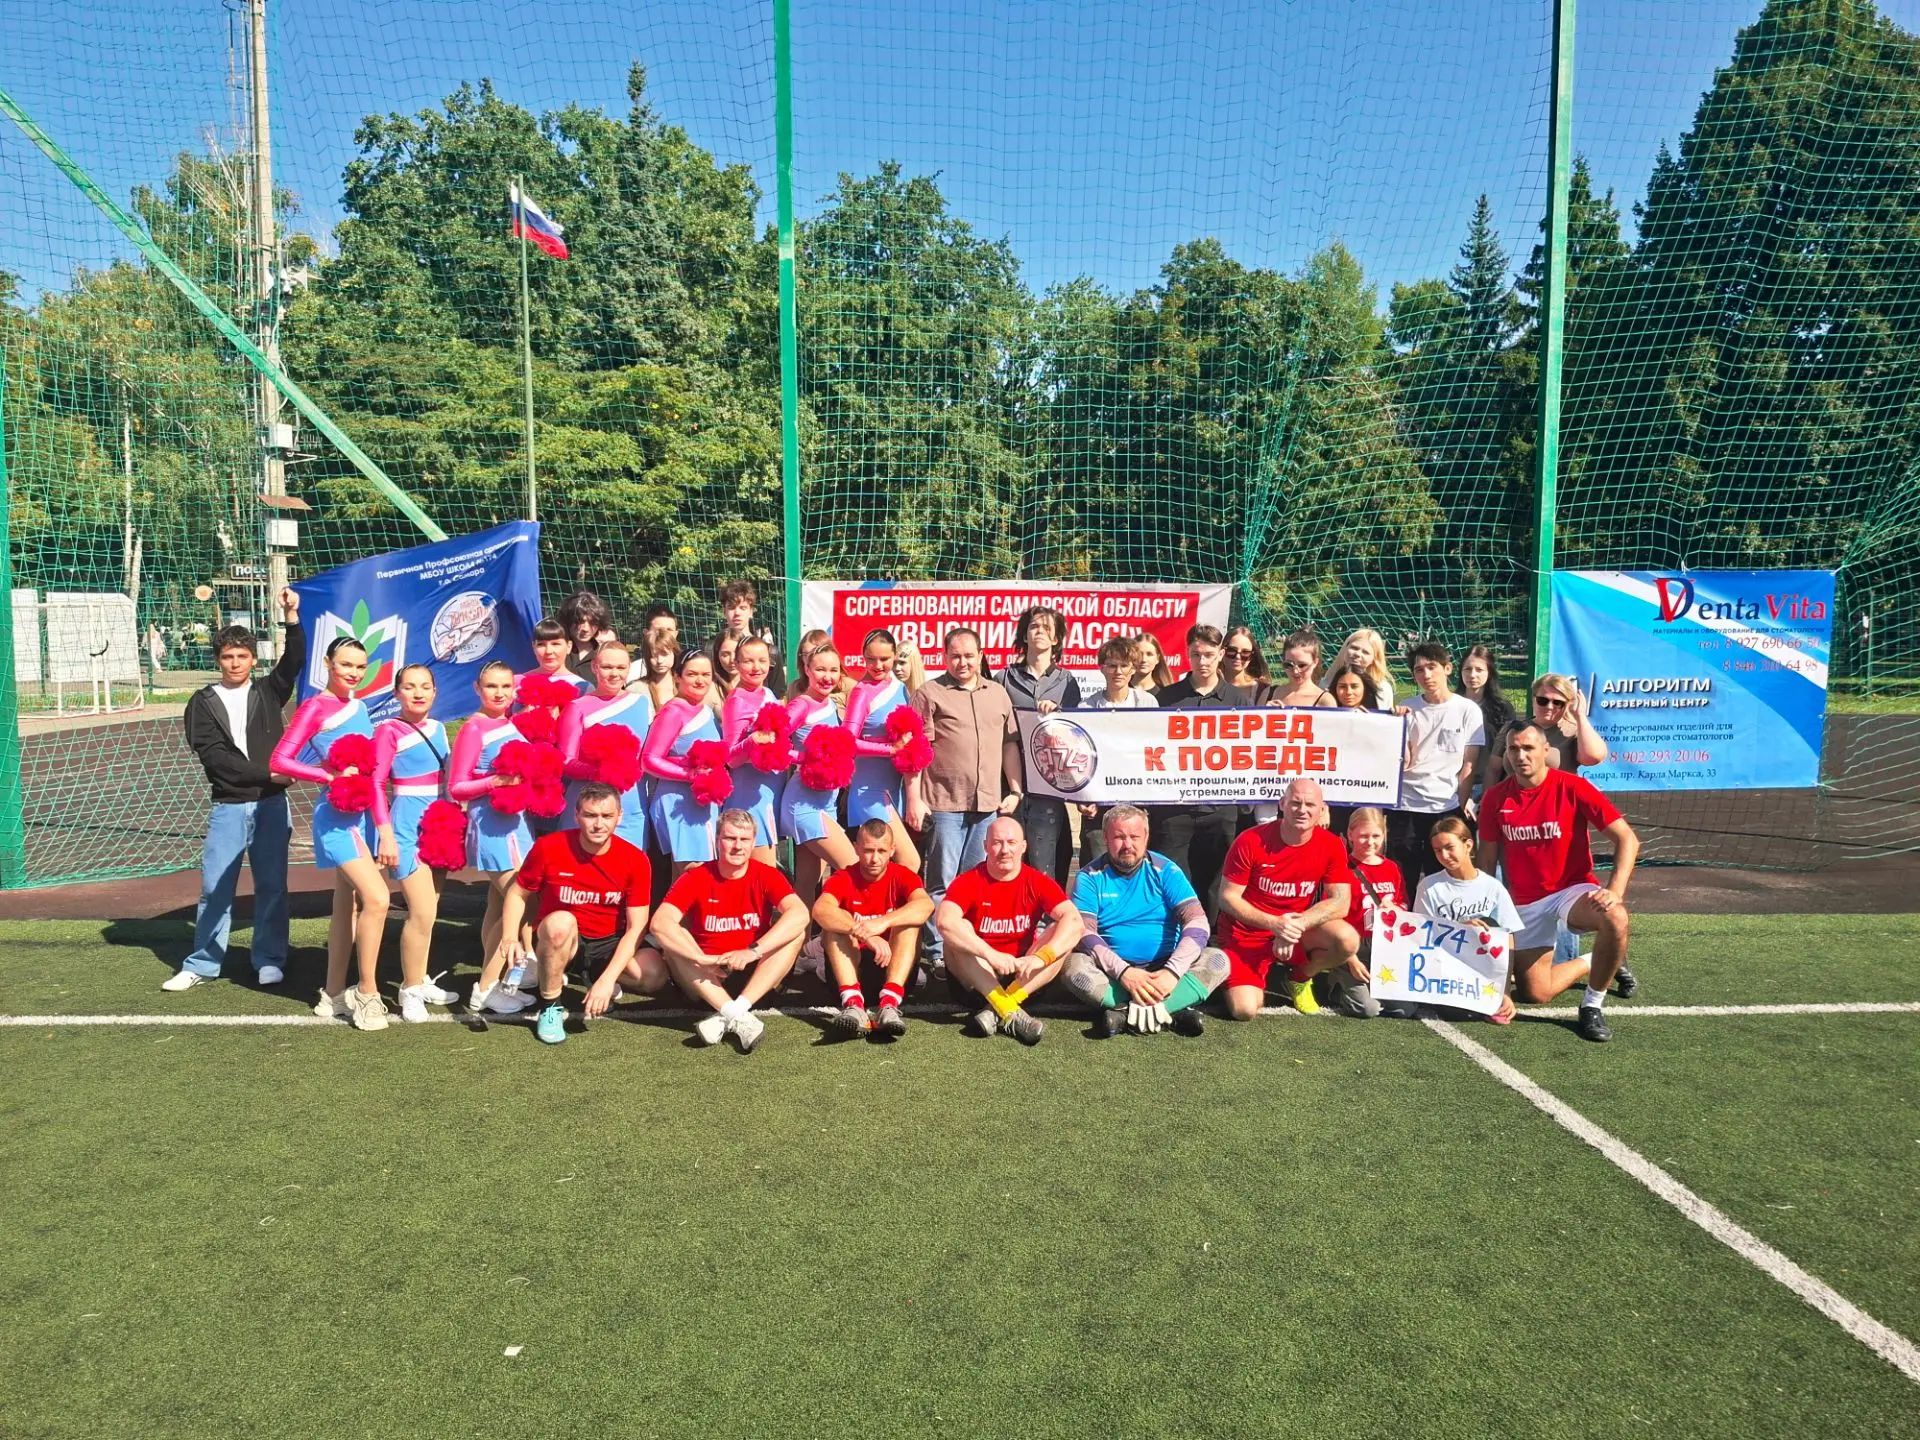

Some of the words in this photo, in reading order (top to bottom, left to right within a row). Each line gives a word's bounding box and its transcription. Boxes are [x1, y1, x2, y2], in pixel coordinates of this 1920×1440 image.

[845, 595, 985, 617] СОРЕВНОВАНИЯ
[1103, 597, 1187, 618] ОБЛАСТИ
[1764, 593, 1826, 620] Vita
[1603, 678, 1712, 693] АЛГОРИТМ
[1600, 697, 1668, 709] ФРЕЗЕРНЫЙ
[1671, 698, 1708, 709] ЦЕНТР
[1167, 714, 1313, 744] ВПЕРЕД
[1716, 722, 1734, 731] для
[1630, 734, 1671, 744] докторов
[1672, 732, 1735, 743] стоматологов
[1144, 746, 1167, 771] К
[1178, 746, 1337, 776] ПОБЕДЕ!
[1638, 769, 1666, 780] Карла
[1706, 768, 1717, 777] 33
[1105, 776, 1143, 786] Школа
[1190, 776, 1249, 788] прошлым,
[1319, 777, 1389, 790] настоящим,
[1179, 788, 1246, 798] устремлена
[1542, 821, 1562, 840] 174
[1419, 920, 1468, 954] 174
